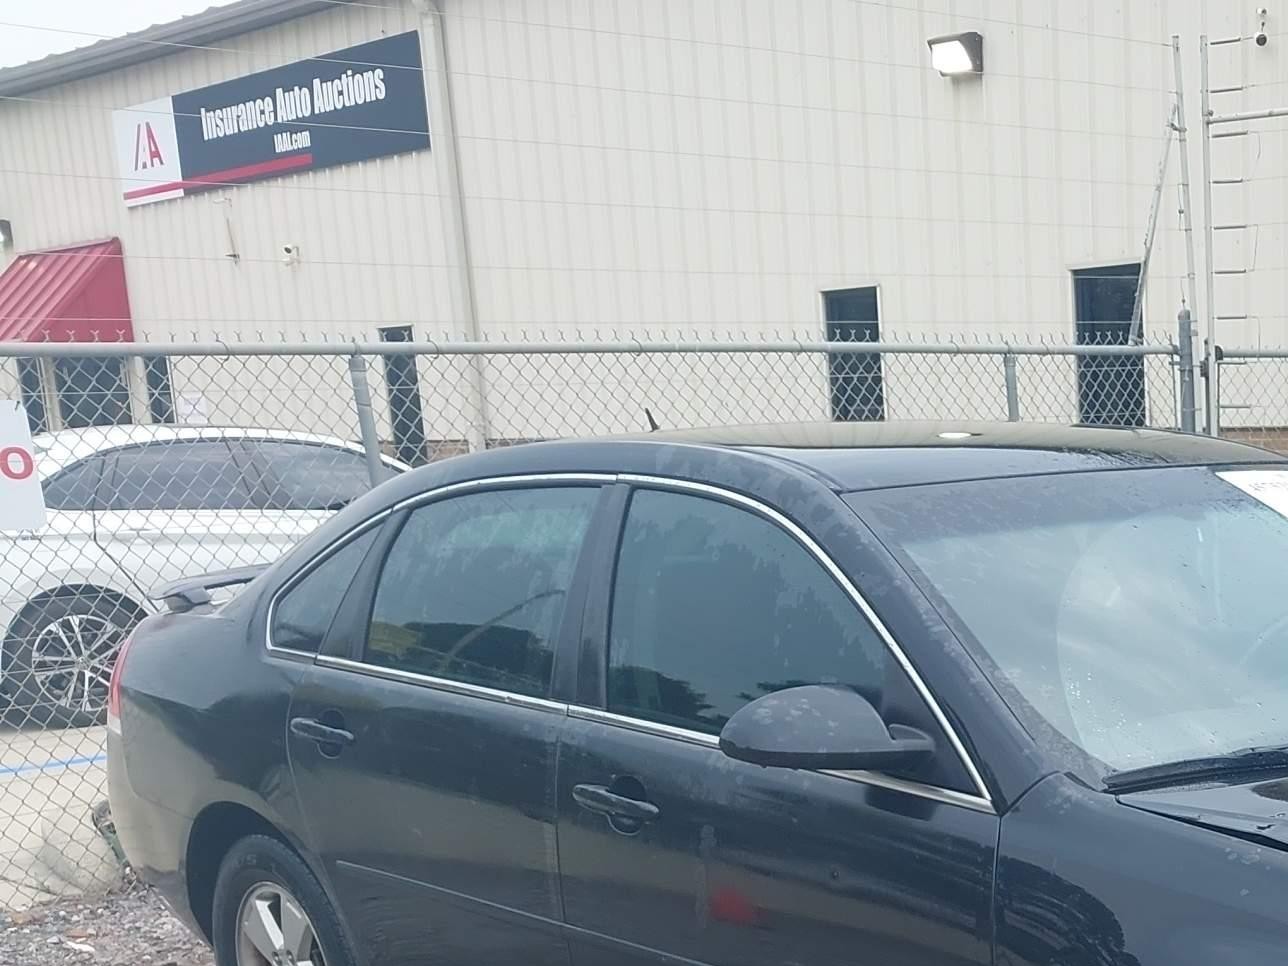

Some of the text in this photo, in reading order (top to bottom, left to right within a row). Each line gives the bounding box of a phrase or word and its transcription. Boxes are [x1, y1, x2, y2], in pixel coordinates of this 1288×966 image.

[201, 68, 386, 141] Insurance Auto Auctions
